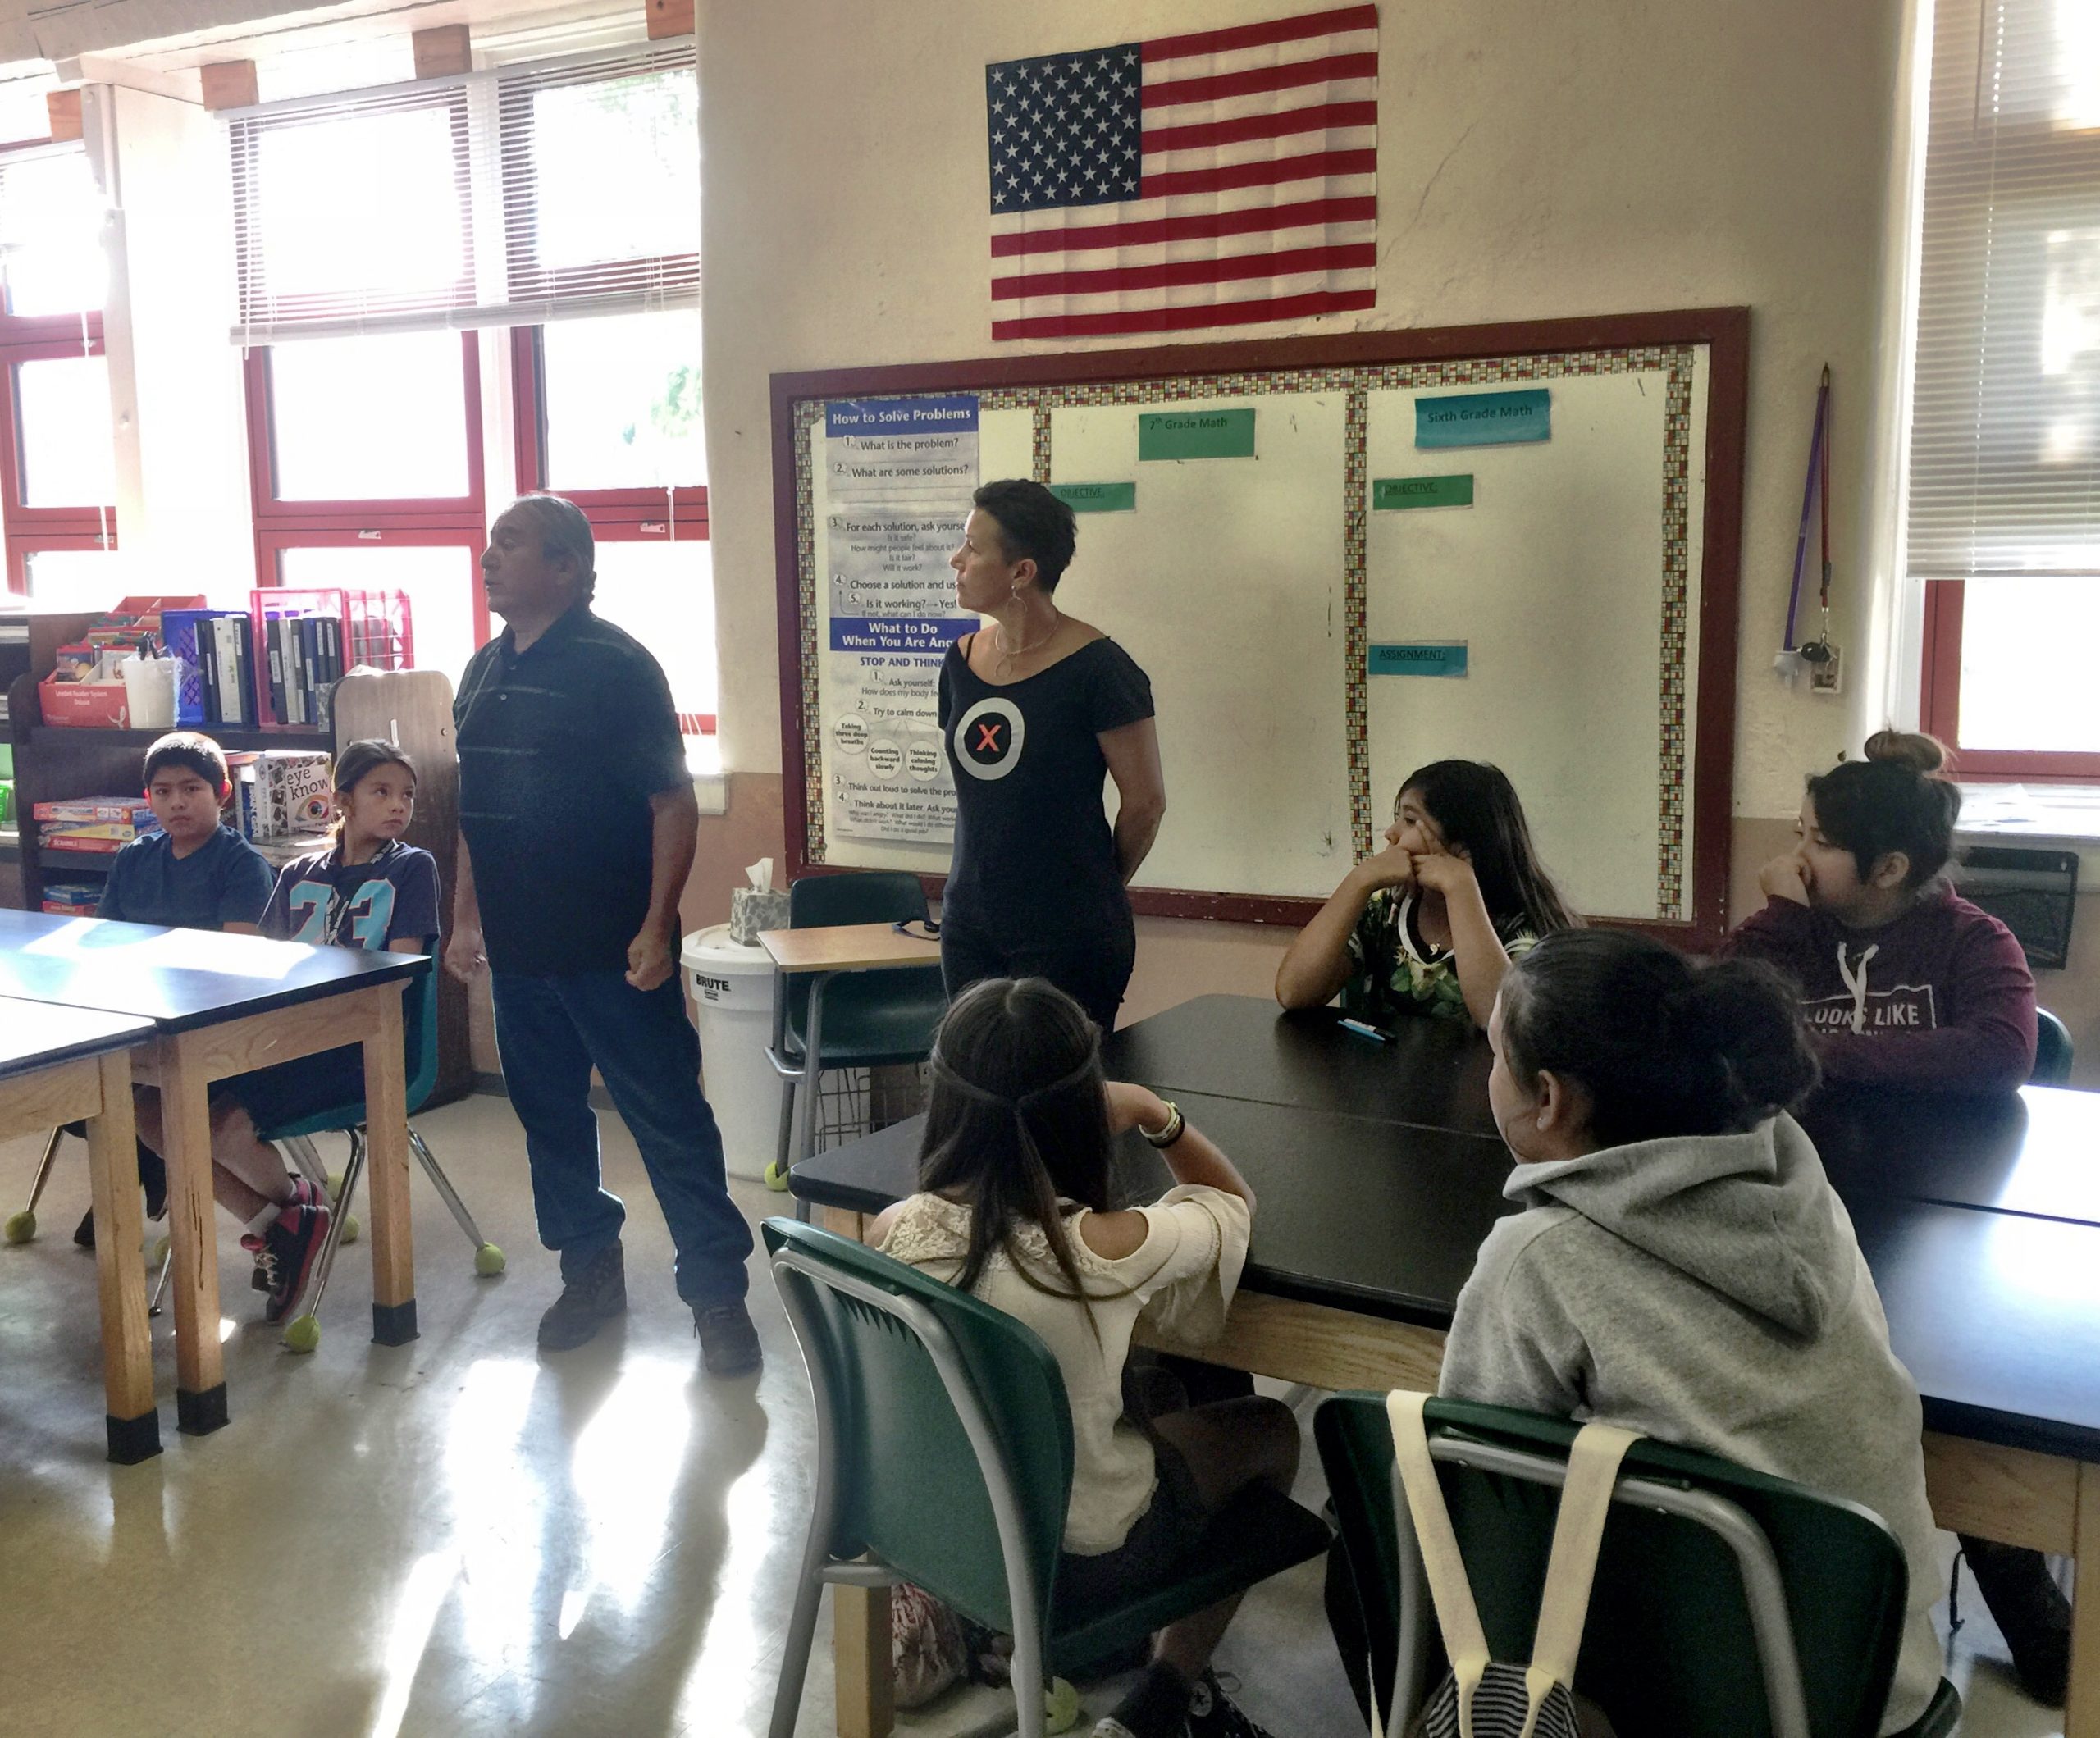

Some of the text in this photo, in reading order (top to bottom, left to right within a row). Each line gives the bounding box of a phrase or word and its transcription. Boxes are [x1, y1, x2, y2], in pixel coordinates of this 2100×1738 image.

[833, 408, 970, 424] How to Solve Problems
[1428, 405, 1532, 422] Sixth Grade Math
[1166, 419, 1196, 429] Grade
[1200, 417, 1227, 427] Math
[861, 441, 884, 451] What
[888, 440, 894, 449] is
[897, 440, 911, 449] the
[915, 438, 958, 451] problem?
[852, 468, 876, 477] What
[923, 464, 968, 476] solutions?
[847, 523, 860, 532] For
[862, 522, 881, 531] each
[883, 522, 919, 532] solution,
[921, 522, 934, 531] ask
[868, 545, 887, 553] might
[888, 545, 911, 553] people
[851, 581, 881, 590] Choose
[891, 581, 925, 589] solution
[927, 580, 943, 589] and
[866, 600, 873, 609] Is
[875, 600, 882, 609] it
[884, 600, 926, 609] working?
[939, 599, 956, 609] Yes!
[869, 623, 938, 633] What to Do
[842, 636, 876, 646] When
[880, 636, 901, 646] You
[905, 637, 925, 647] Are
[861, 657, 885, 666] STOP
[888, 658, 910, 667] AND
[903, 678, 934, 689] yourself:
[880, 687, 896, 696] does
[911, 688, 929, 699] body
[874, 707, 884, 717] Try
[897, 708, 914, 716] calm
[916, 708, 937, 717] down
[871, 748, 898, 756] Counting
[287, 769, 312, 787] eye
[290, 779, 328, 801] know
[849, 782, 868, 791] Think
[883, 784, 898, 793] loud
[901, 786, 908, 794] to
[910, 787, 928, 795] solve
[929, 787, 942, 796] the
[854, 800, 874, 809] Think
[876, 801, 897, 810] about
[927, 804, 938, 812] Ask
[696, 974, 728, 991] BRUTE
[1874, 1002, 1920, 1025] LIKE
